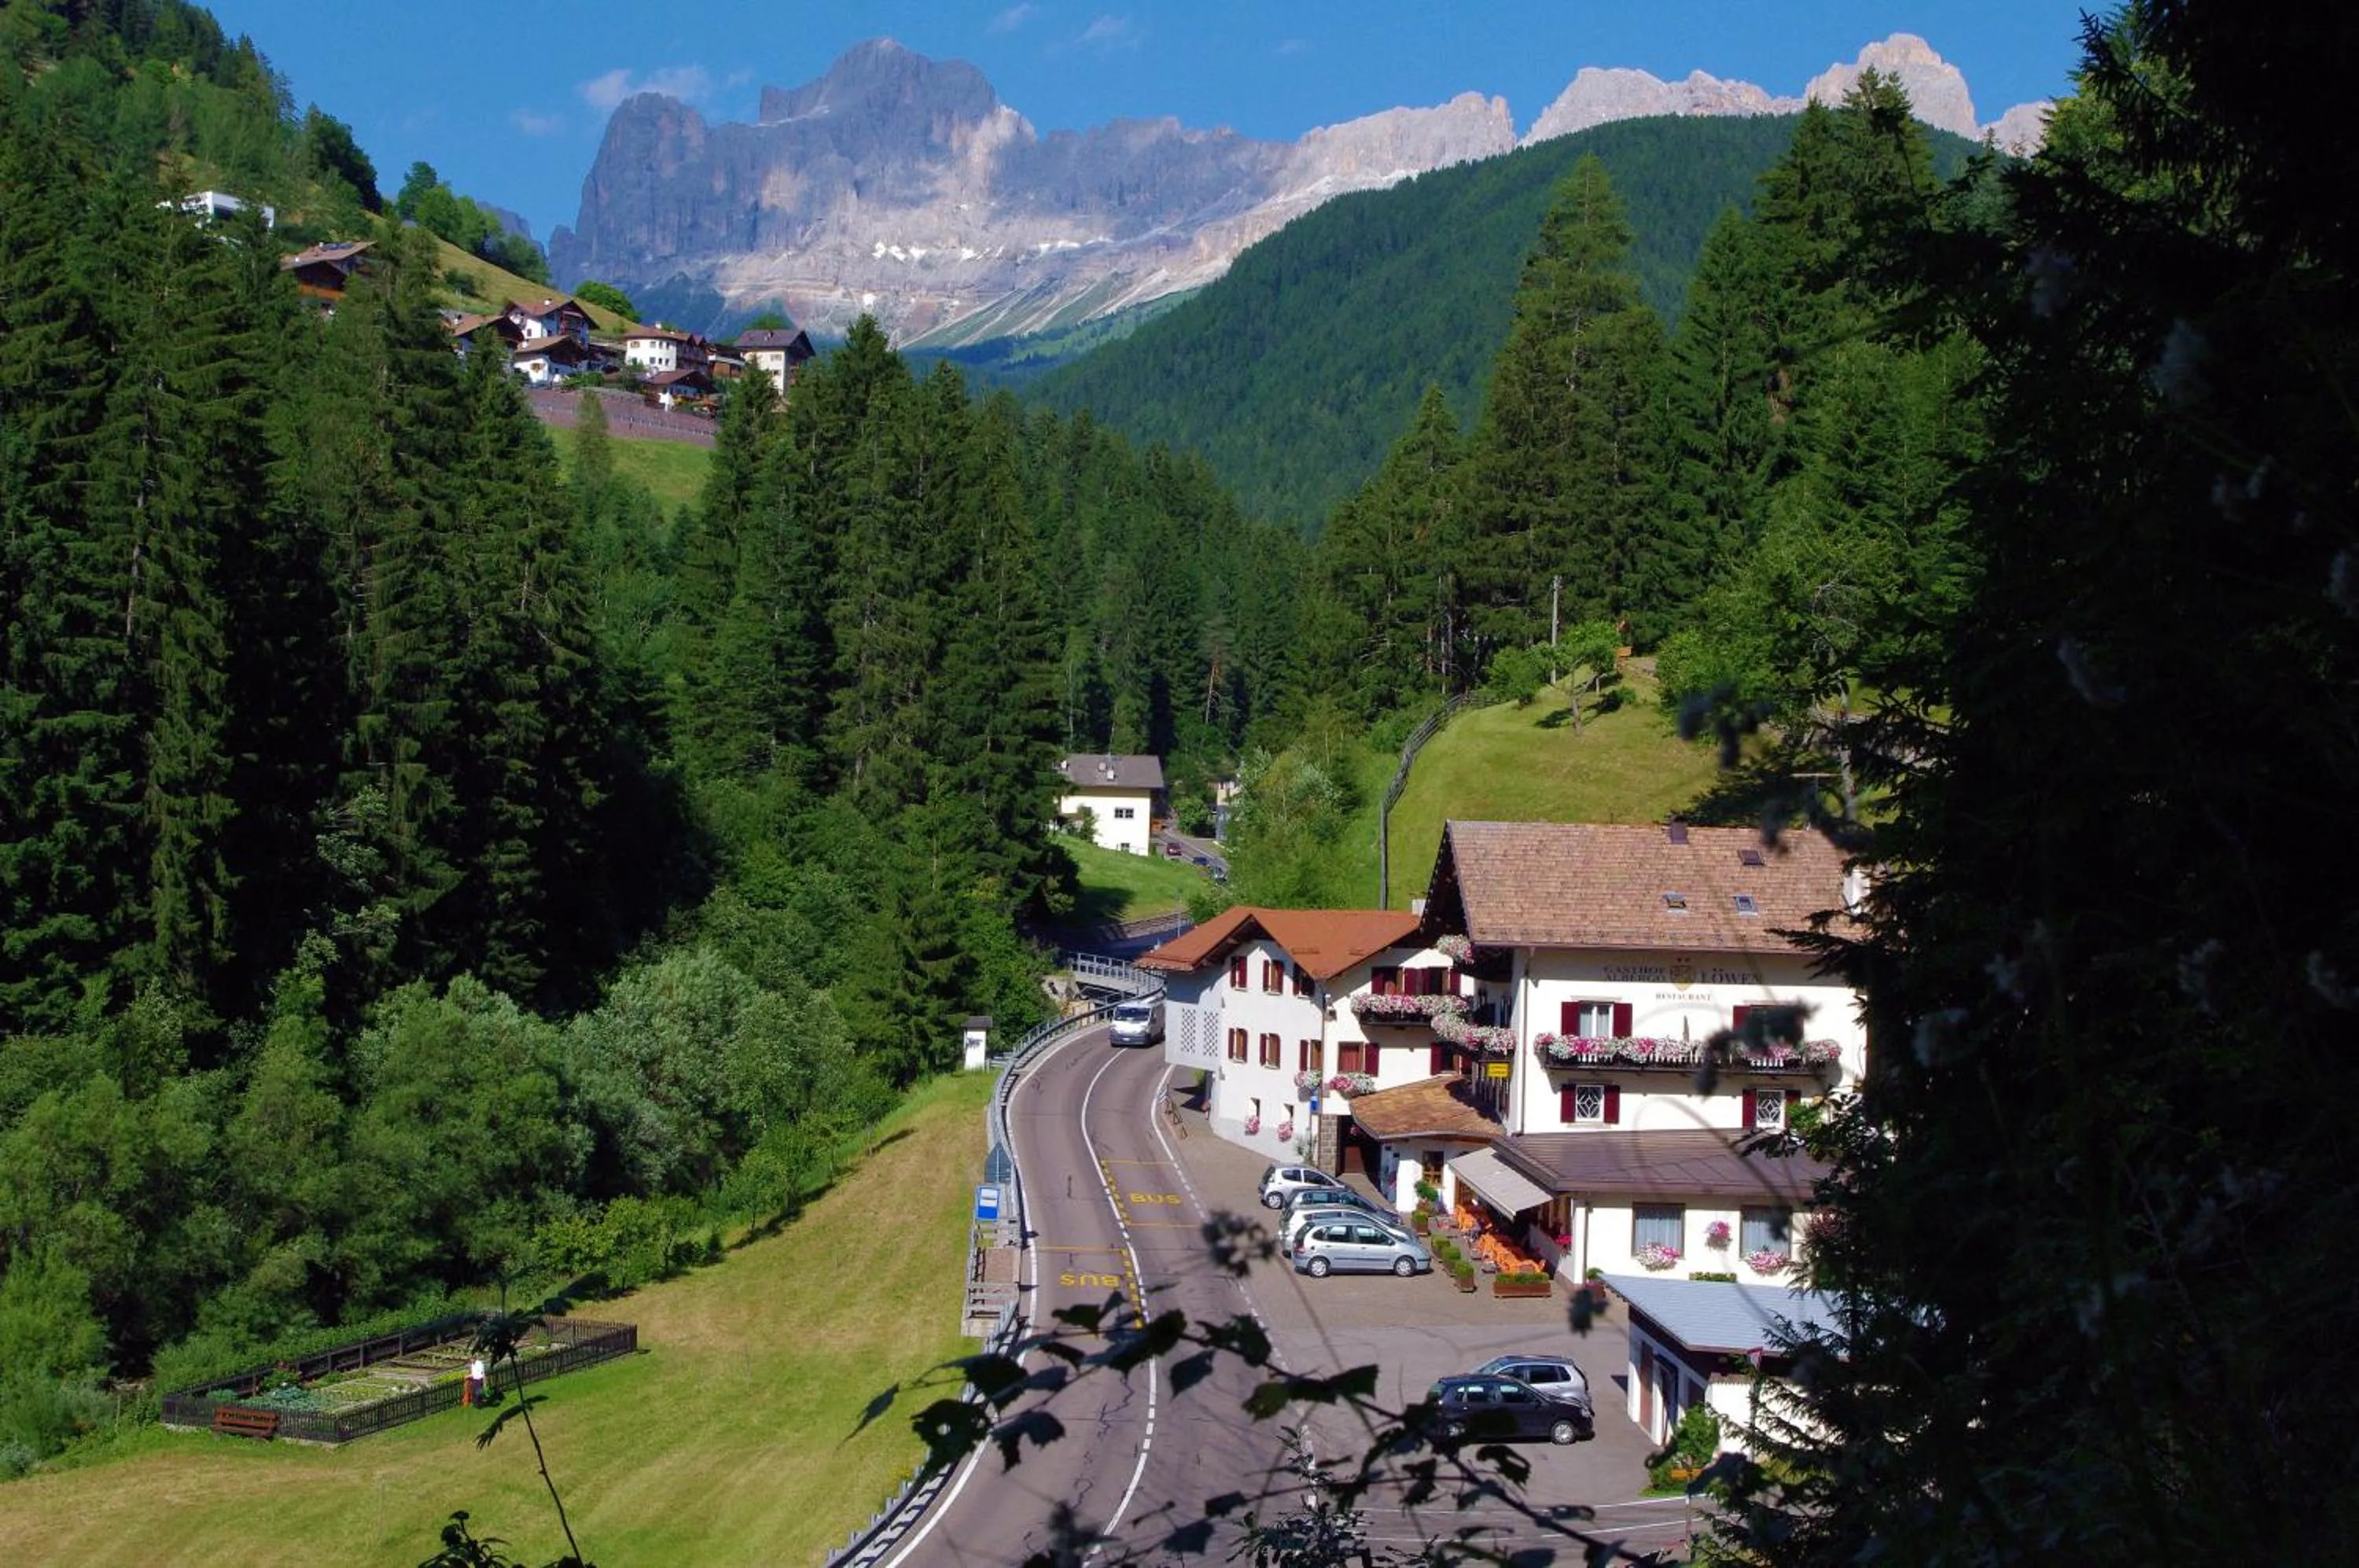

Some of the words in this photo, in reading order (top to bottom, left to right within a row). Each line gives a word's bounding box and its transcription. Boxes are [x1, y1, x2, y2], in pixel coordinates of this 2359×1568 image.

[1700, 968, 1762, 984] LÖWEN
[1655, 992, 1712, 1001] RESTAURANT
[1129, 1193, 1182, 1205] BUS
[1059, 1274, 1120, 1287] BUS
